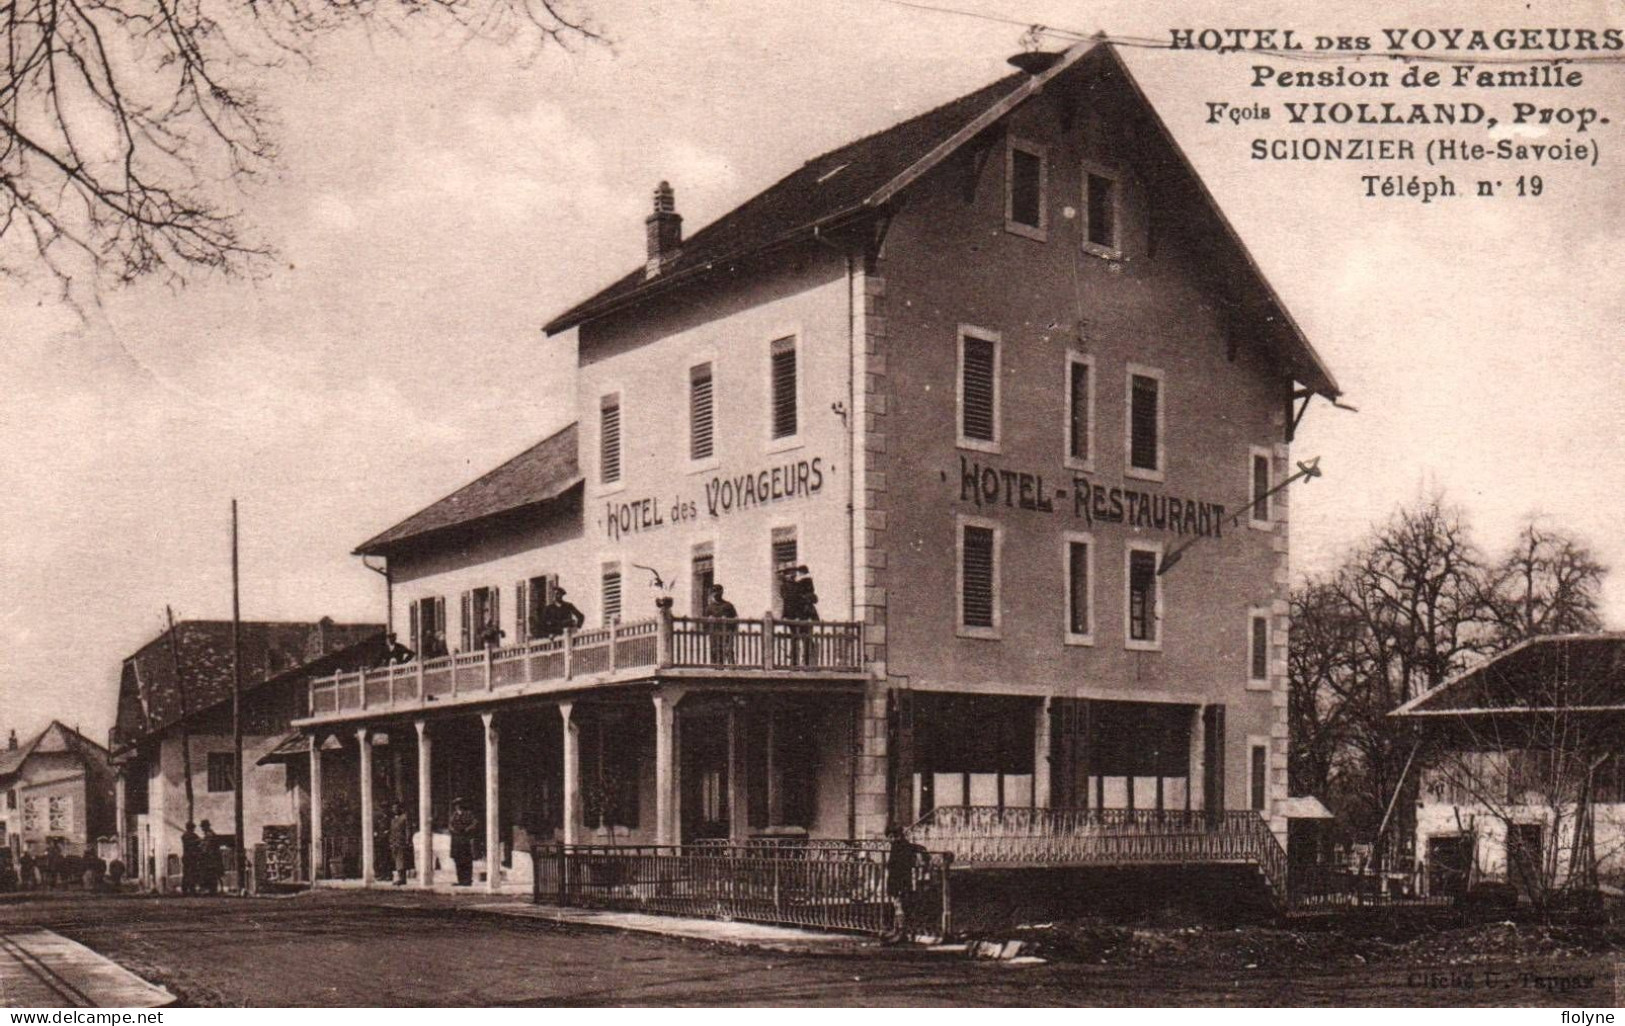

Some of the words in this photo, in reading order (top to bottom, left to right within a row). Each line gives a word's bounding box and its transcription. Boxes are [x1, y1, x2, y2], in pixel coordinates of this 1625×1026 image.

[607, 498, 663, 541] HOTEL
[671, 495, 697, 523] des
[705, 457, 824, 518] VOYAGEURS
